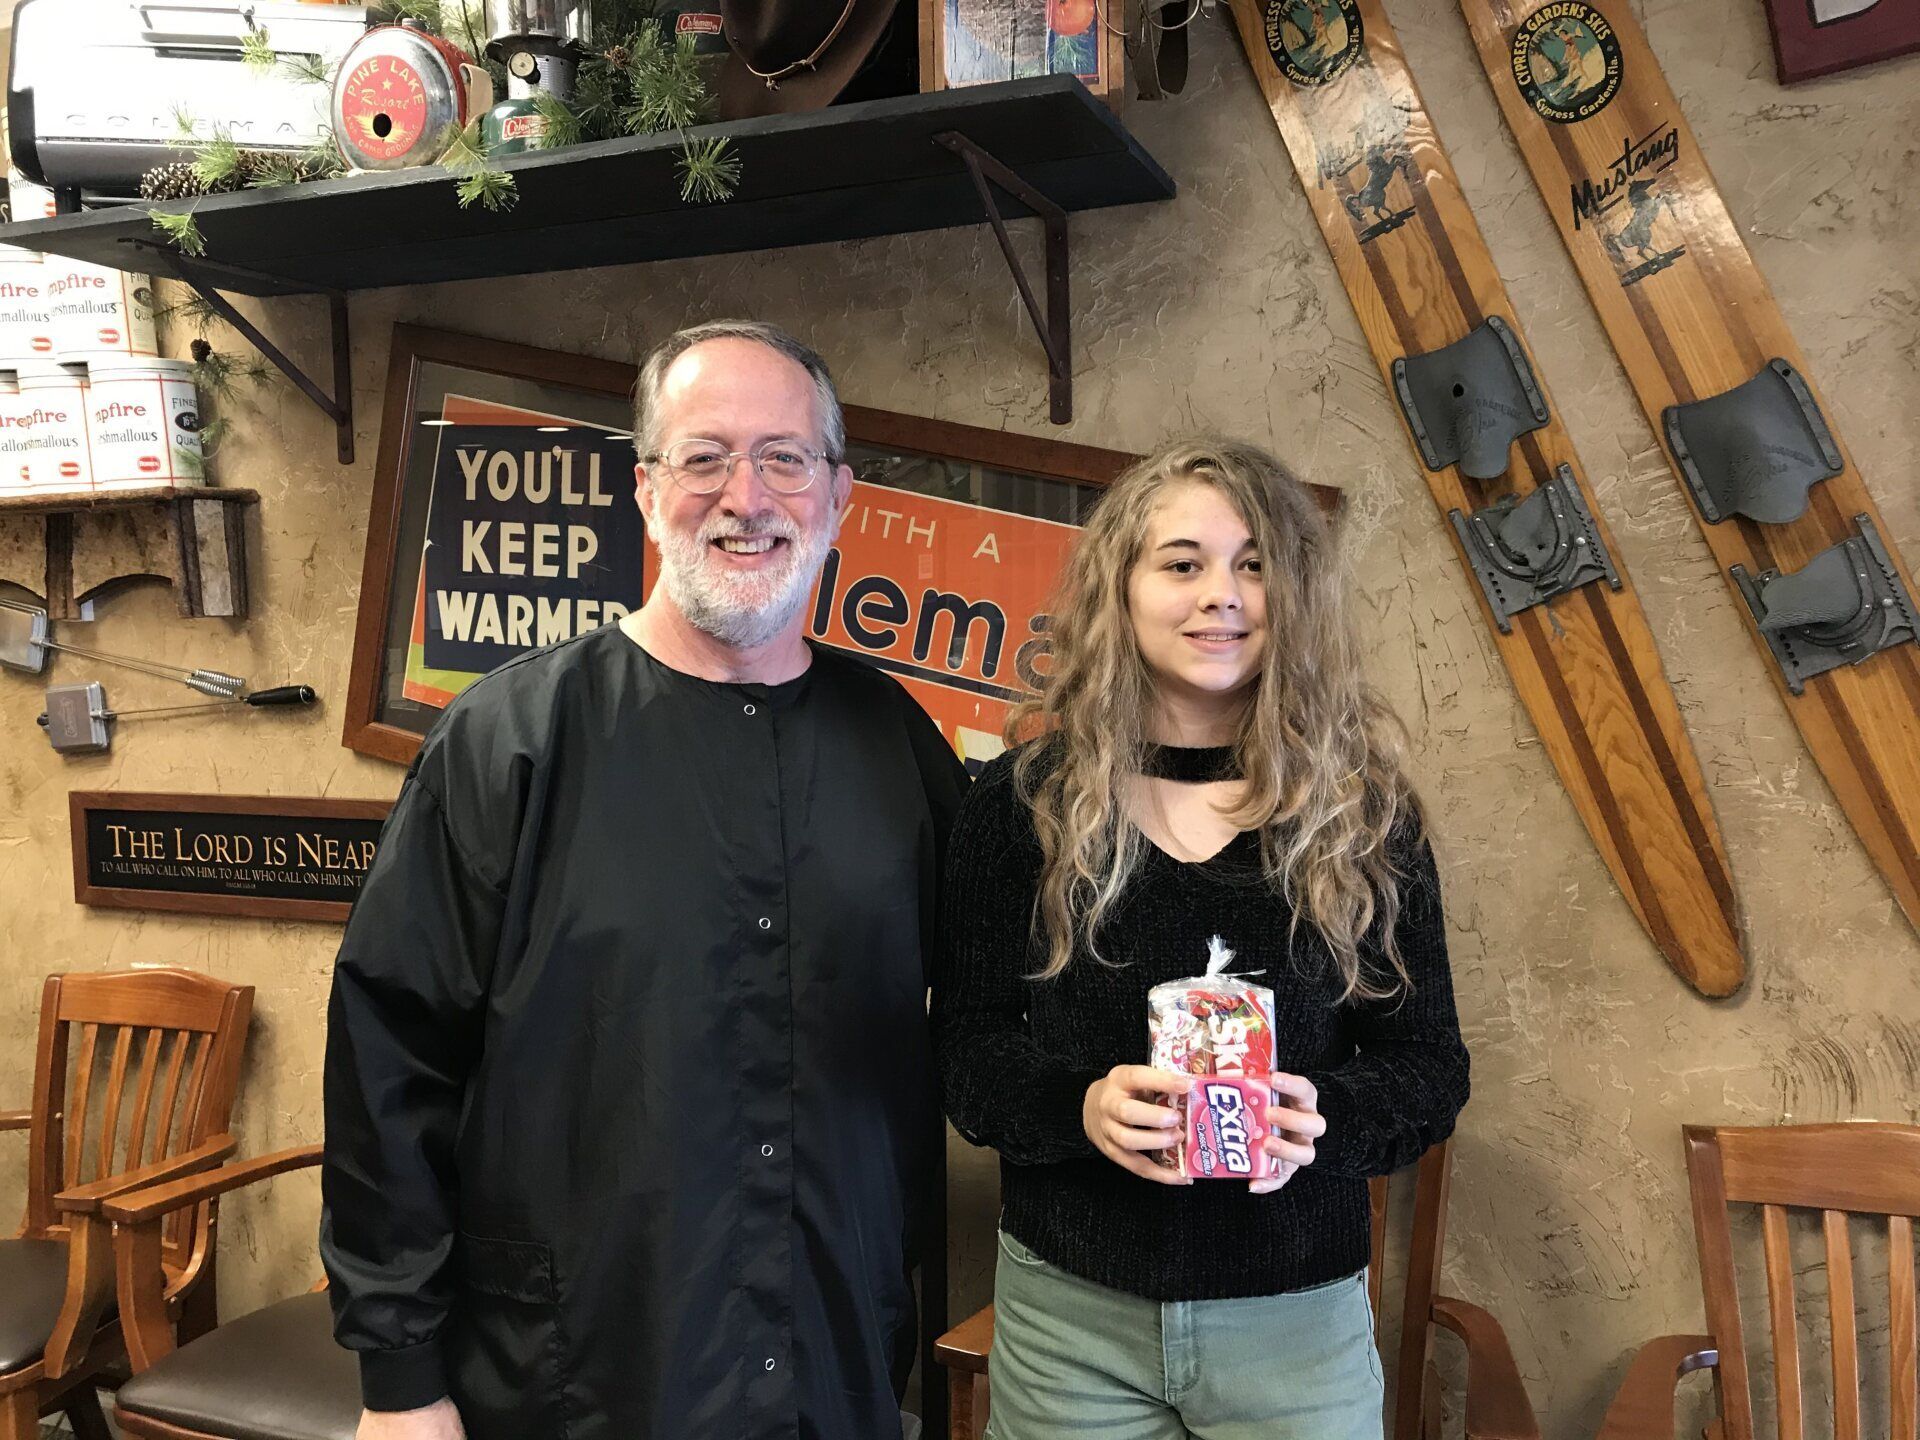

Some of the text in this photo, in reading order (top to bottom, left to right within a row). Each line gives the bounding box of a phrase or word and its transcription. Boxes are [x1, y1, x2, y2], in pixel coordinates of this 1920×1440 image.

[1513, 3, 1611, 86] CYPRESS GARDENS SKIS
[347, 59, 424, 105] PINE LAKE
[1286, 63, 1321, 84] Cypress
[1536, 98, 1575, 119] Cypress
[1571, 121, 1678, 231] Mustang
[456, 445, 614, 507] YOU'LL
[462, 520, 598, 579] KEEP
[972, 532, 1001, 564] A
[106, 824, 166, 860] THE
[174, 827, 254, 865] LORD
[262, 836, 288, 866] IS
[101, 861, 113, 873] TO
[115, 862, 132, 874] ALL
[132, 863, 155, 875] WHO
[156, 865, 179, 877] CALL
[180, 866, 195, 877] ON
[220, 868, 232, 879] TO
[233, 869, 251, 880] ALL
[251, 869, 276, 881] WHO
[277, 871, 301, 884] CALL
[303, 872, 319, 885] ON
[320, 873, 341, 886] HIM
[1196, 1122, 1207, 1150] CLASSIC
[1204, 1084, 1252, 1173] Extra
